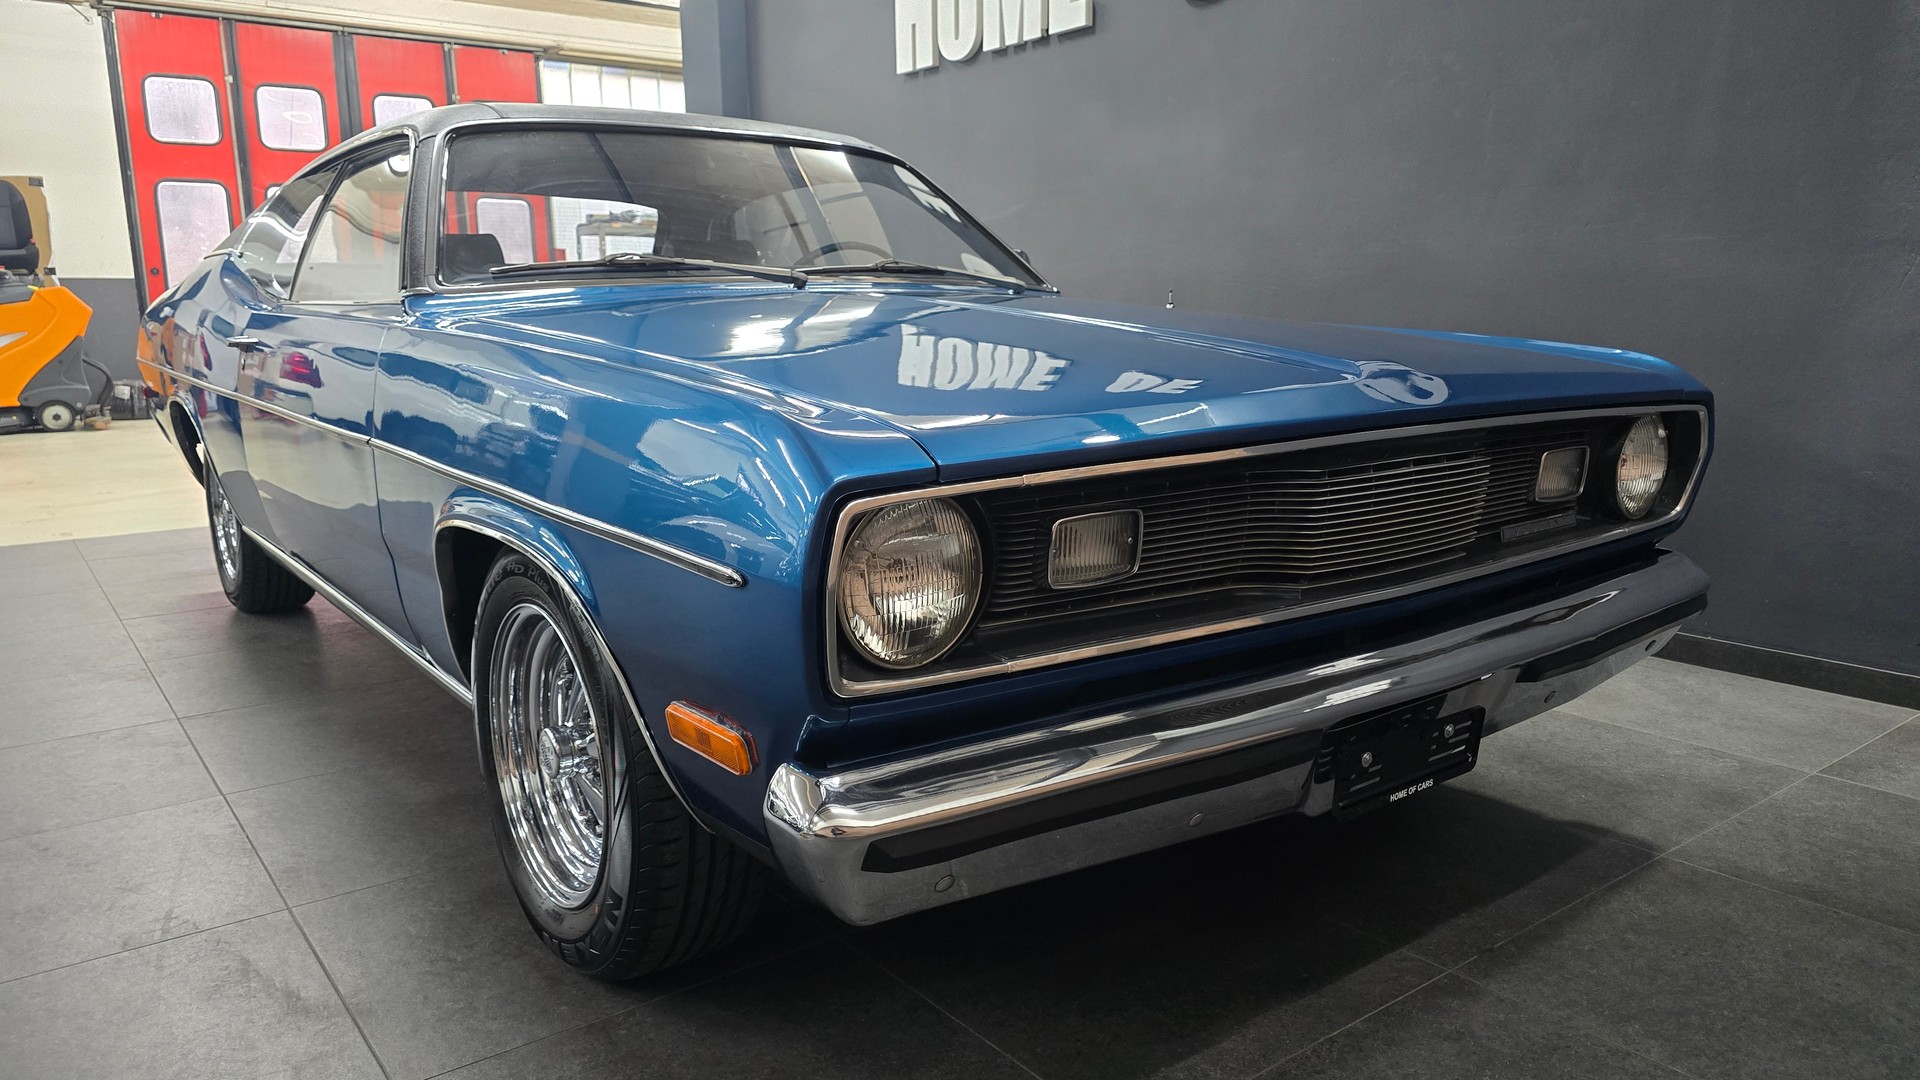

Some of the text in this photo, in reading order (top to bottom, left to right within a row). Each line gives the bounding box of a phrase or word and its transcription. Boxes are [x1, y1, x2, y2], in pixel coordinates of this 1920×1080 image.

[527, 564, 550, 593] Plus
[1390, 778, 1434, 803] HOME OF CARS
[543, 886, 624, 962] NEXEN
